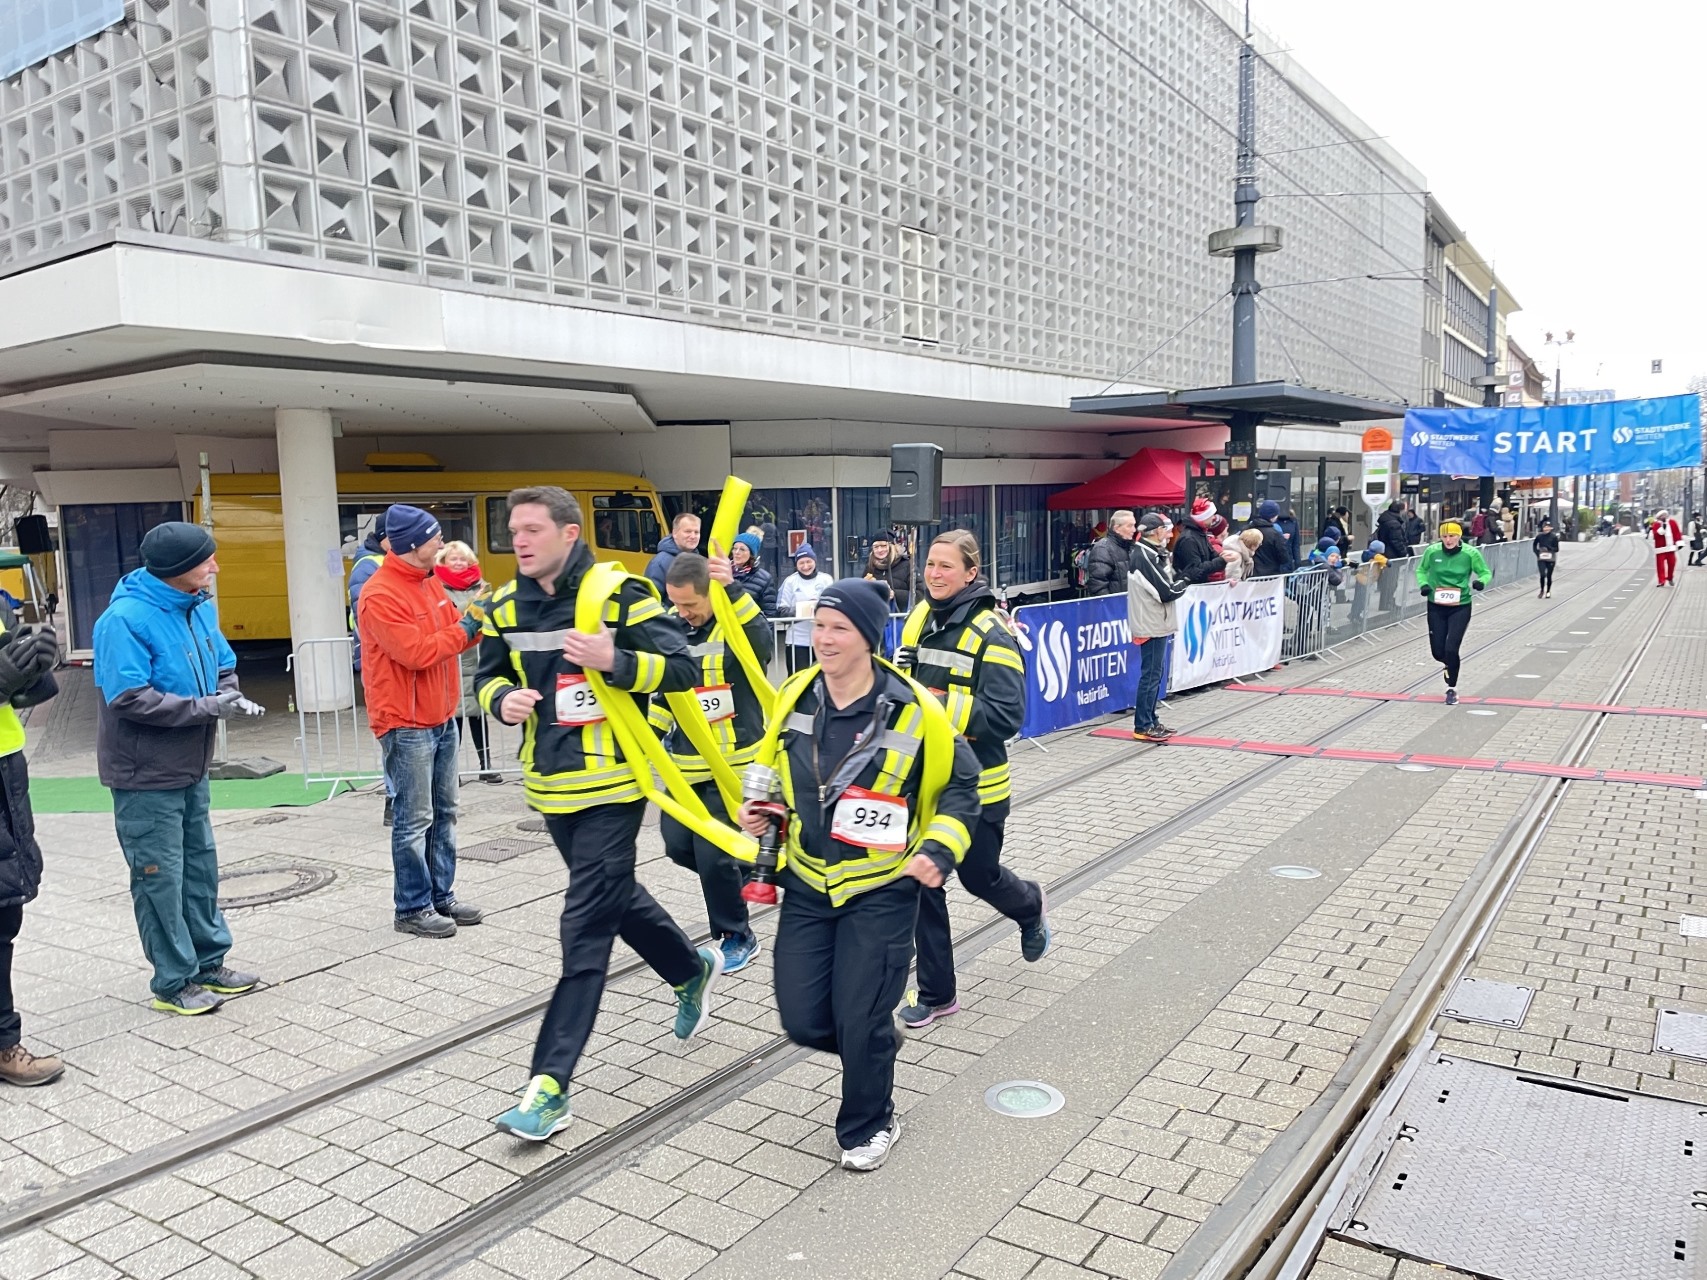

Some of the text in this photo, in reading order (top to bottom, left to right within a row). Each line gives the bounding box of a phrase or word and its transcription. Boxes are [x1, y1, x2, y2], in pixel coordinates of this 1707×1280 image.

[1430, 434, 1480, 442] STADTWERKE
[1493, 428, 1598, 454] START
[1077, 618, 1133, 653] STADTW
[1077, 649, 1127, 684] WITTEN
[575, 689, 597, 707] 93
[698, 697, 720, 712] 39
[854, 807, 892, 830] 934
